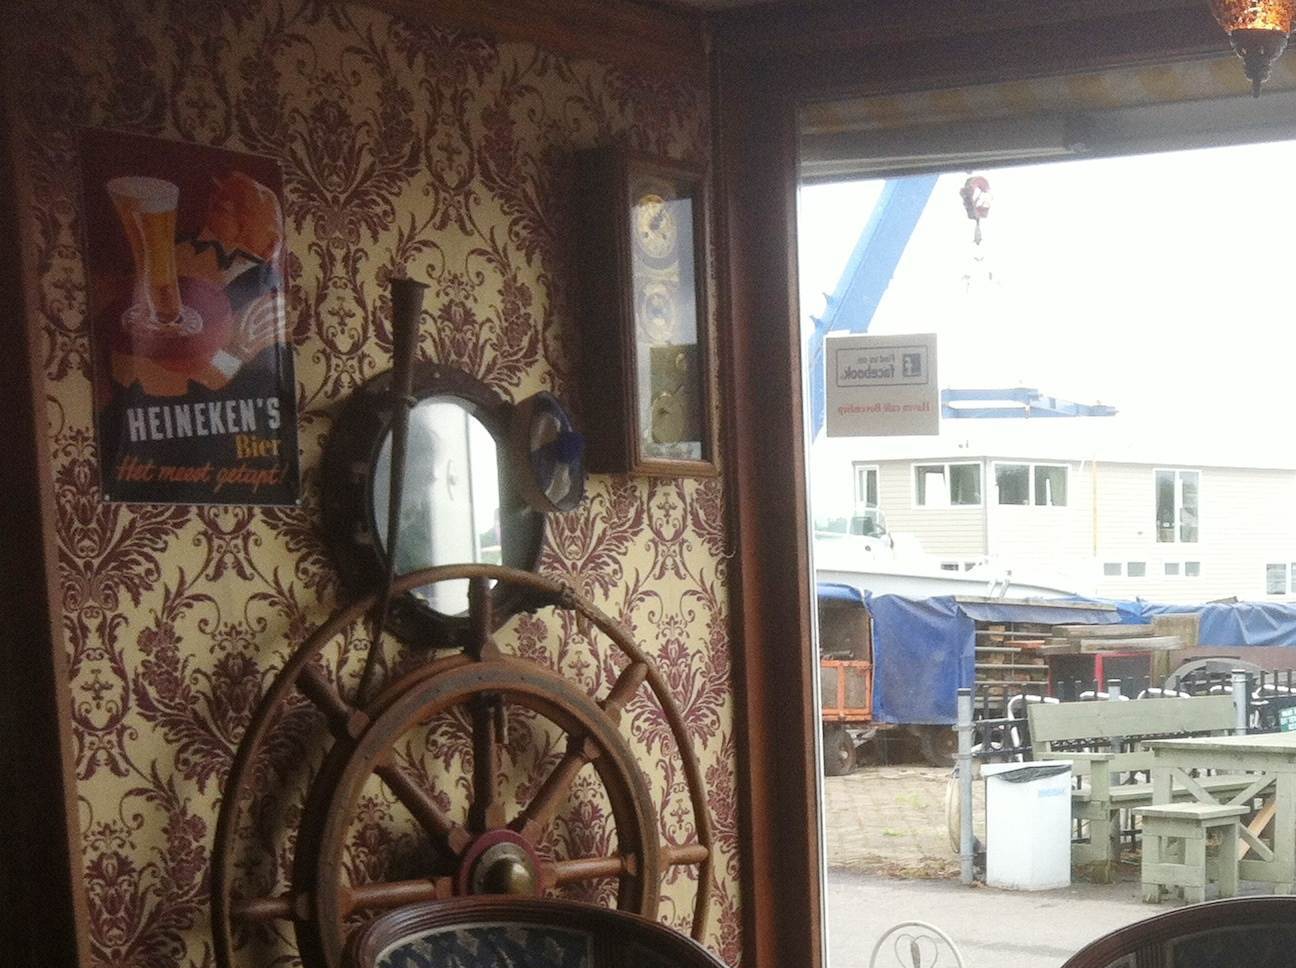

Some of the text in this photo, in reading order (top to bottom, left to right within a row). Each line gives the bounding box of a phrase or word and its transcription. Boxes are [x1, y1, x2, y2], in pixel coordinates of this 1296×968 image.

[127, 397, 281, 442] HEINEKEN'S
[236, 434, 281, 459] Bier
[117, 455, 154, 482] Het
